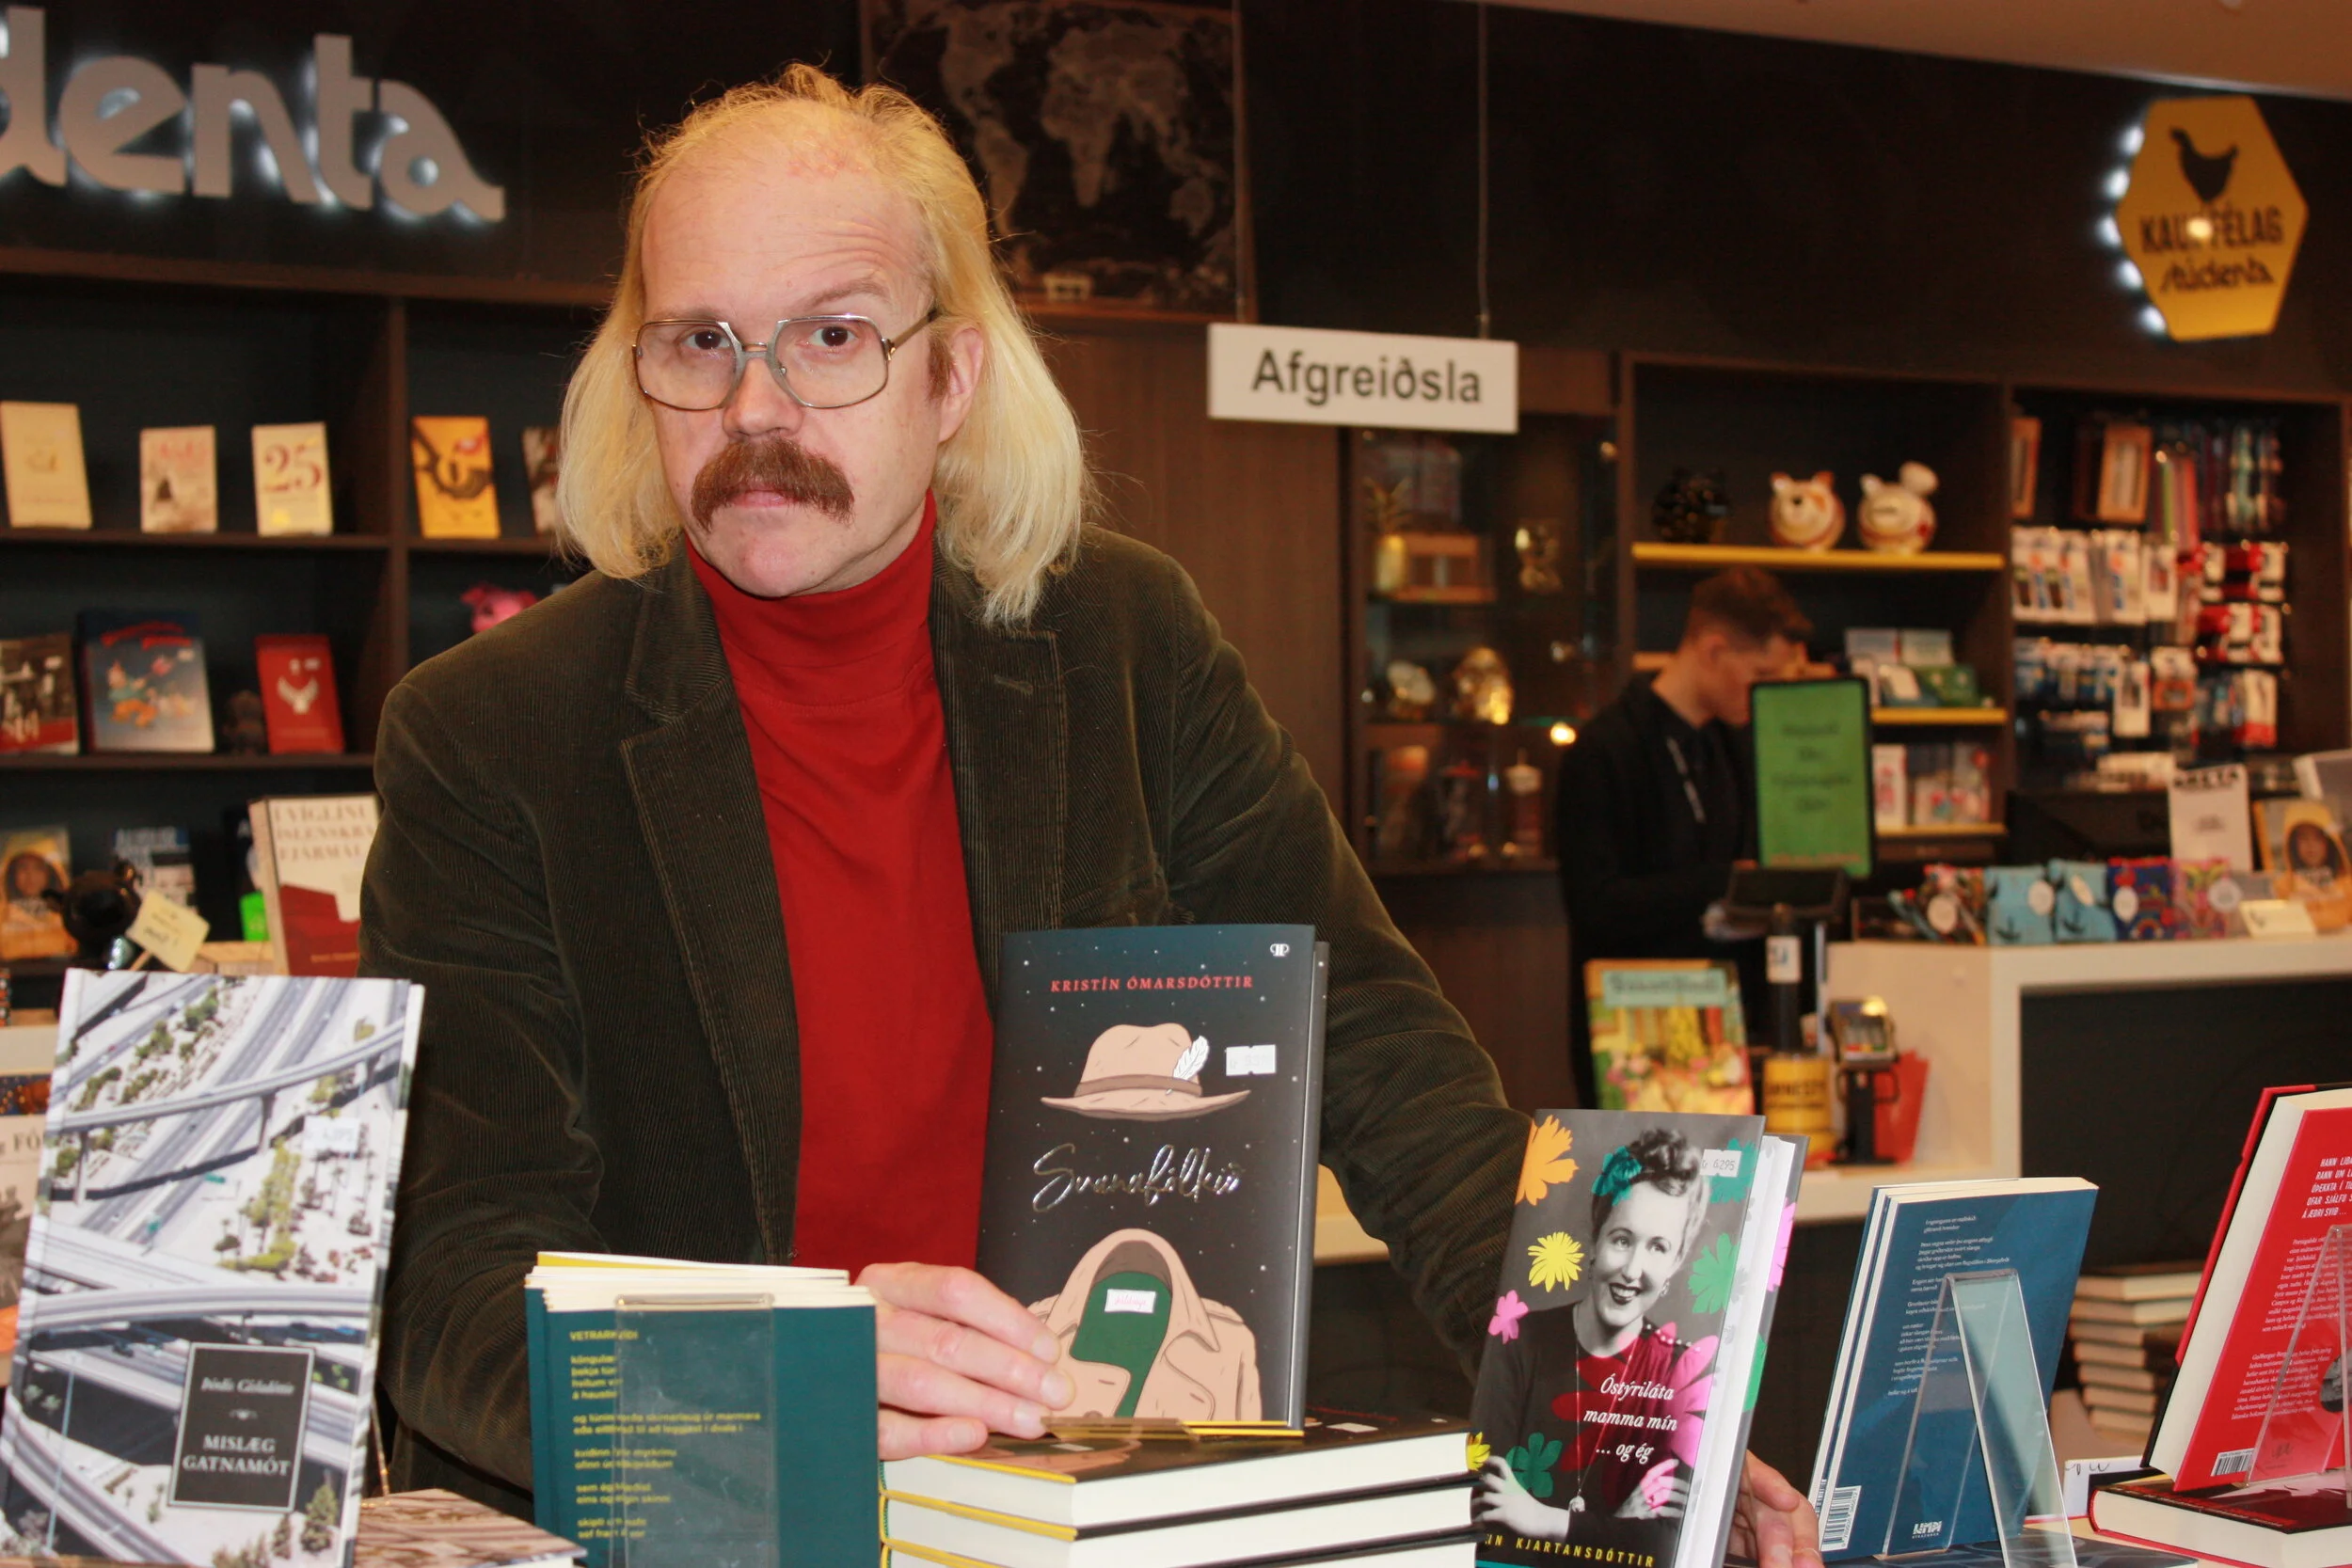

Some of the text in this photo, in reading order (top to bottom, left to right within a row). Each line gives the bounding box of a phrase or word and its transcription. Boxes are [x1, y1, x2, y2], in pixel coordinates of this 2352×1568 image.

[2139, 203, 2284, 254] KAUFÉLAG
[1250, 347, 1483, 407] Afgreiðsla
[263, 444, 322, 492] 25
[1050, 974, 1254, 992] KRISTÍN ÓMARSDÓTTIR
[1032, 1142, 1247, 1212] Svanafólkið
[1600, 1372, 1675, 1401] Óstýriláta
[1582, 1410, 1677, 1432] mamma mín
[202, 1434, 277, 1453] MISLÆG
[1615, 1444, 1636, 1463] og
[1635, 1442, 1654, 1465] ég
[182, 1454, 291, 1476] GATNAMÓT
[1516, 1538, 1655, 1567] KJARTANSDÓTTIR
